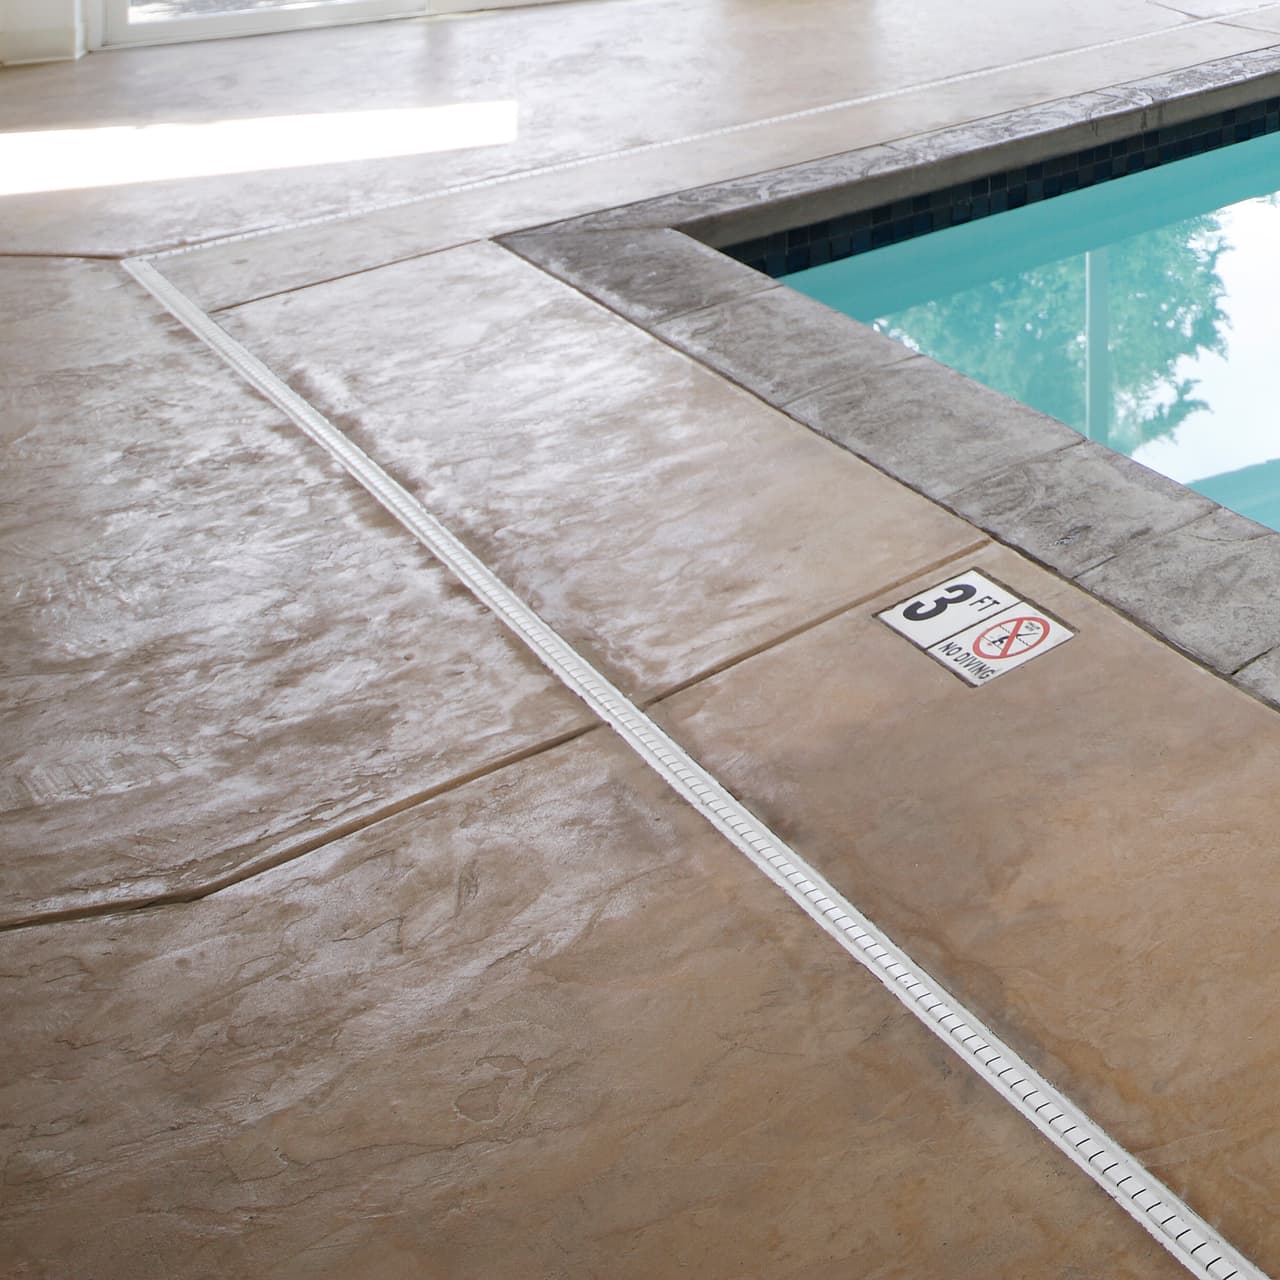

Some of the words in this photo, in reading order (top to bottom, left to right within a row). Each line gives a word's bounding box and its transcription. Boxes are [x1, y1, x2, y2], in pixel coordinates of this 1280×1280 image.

[903, 584, 977, 621] 3
[968, 596, 1001, 612] FT
[938, 641, 963, 656] NO
[953, 652, 995, 680] DIVING
